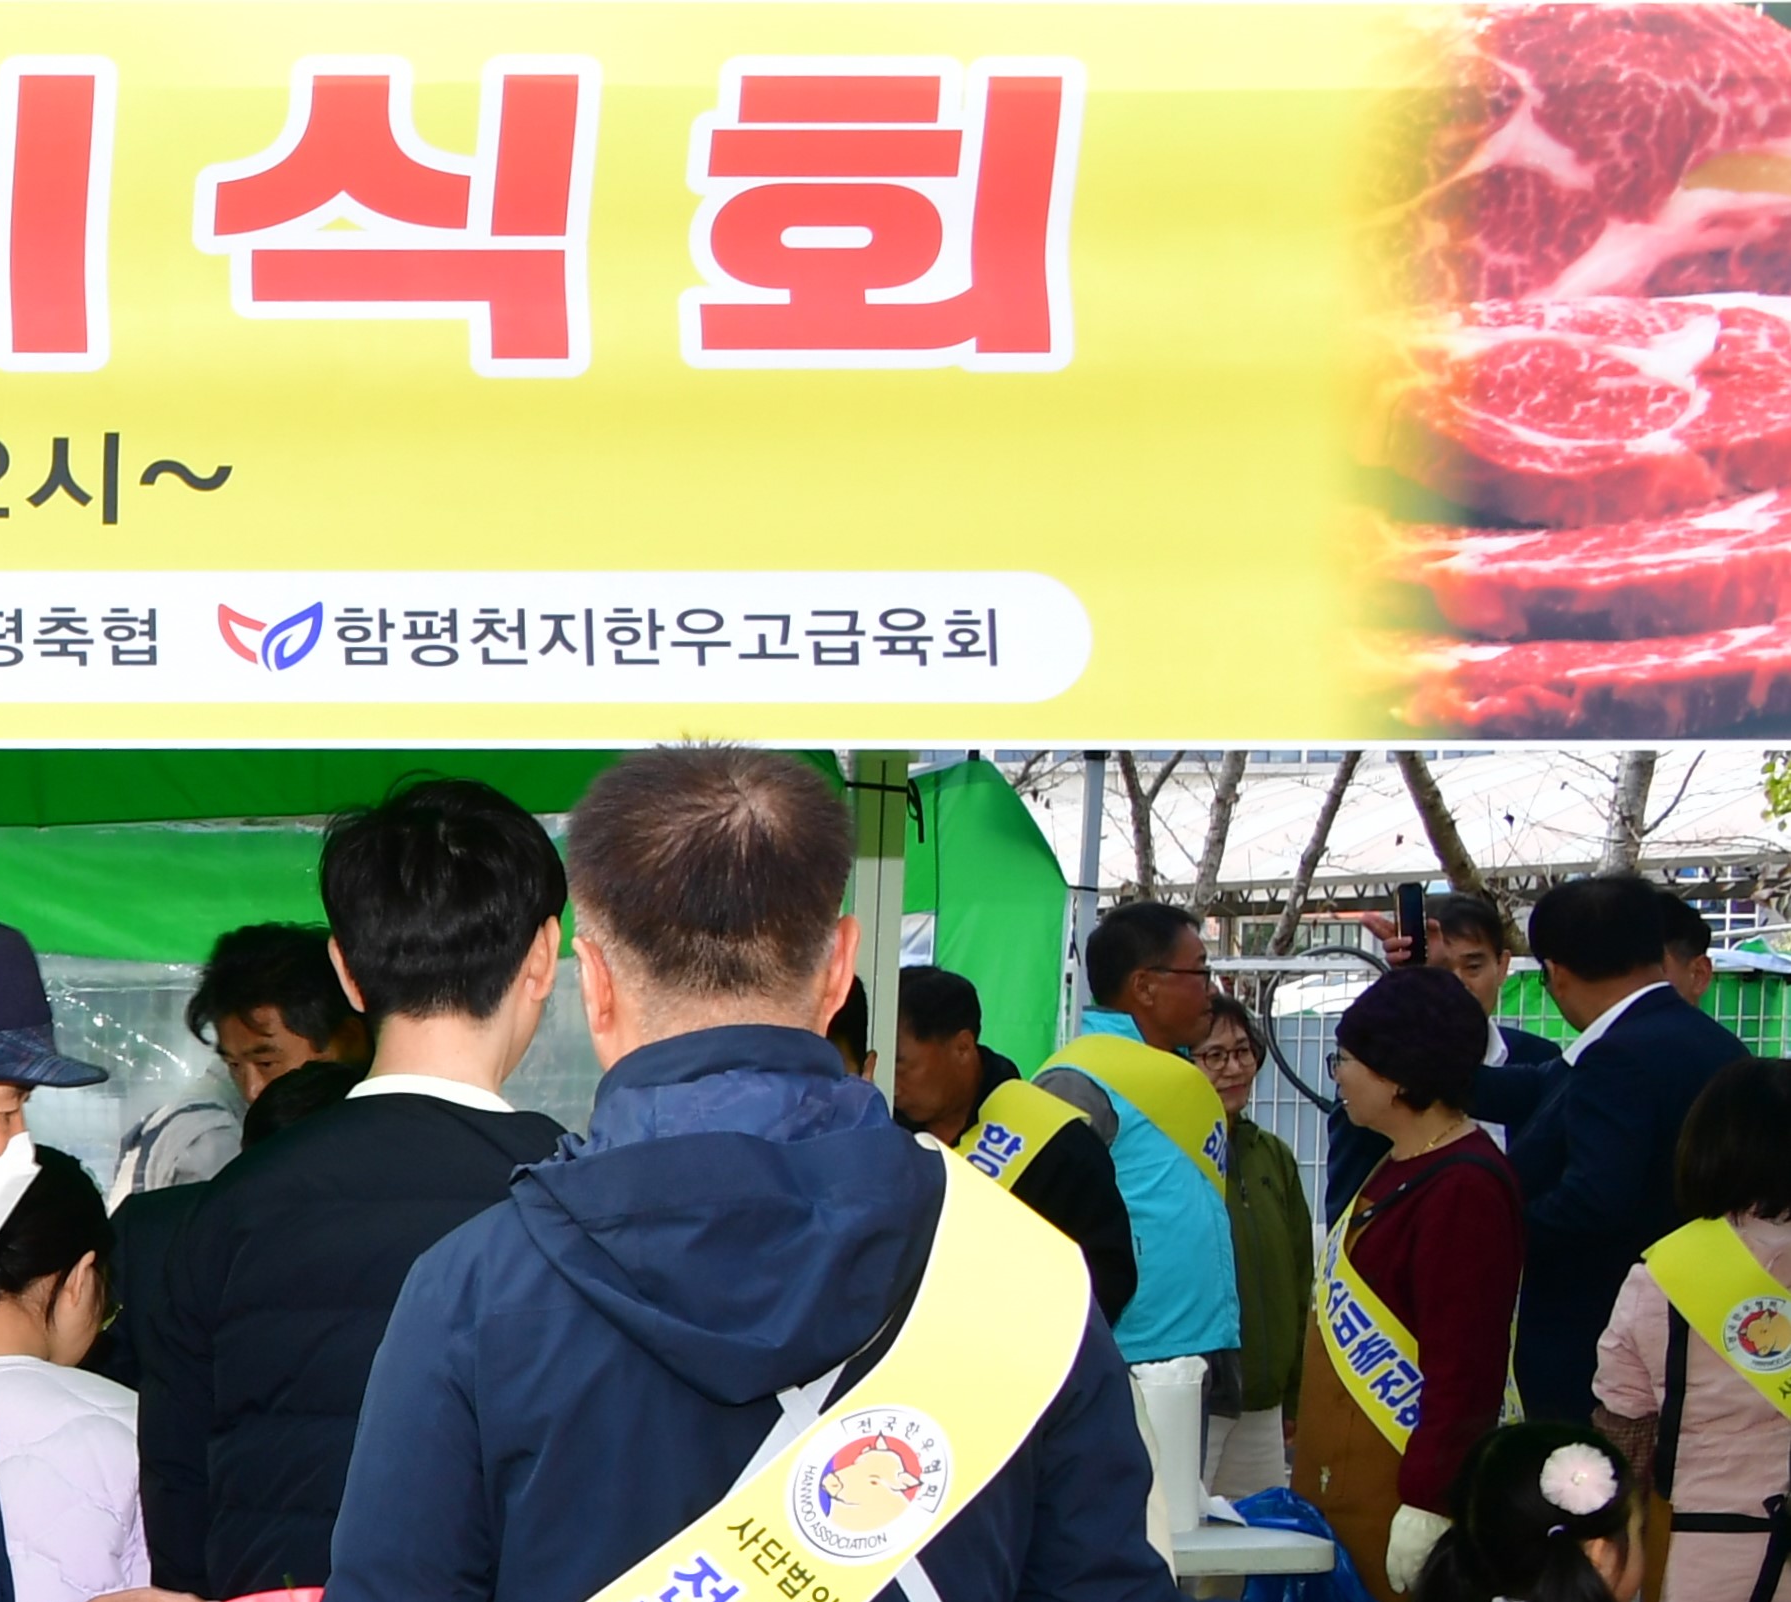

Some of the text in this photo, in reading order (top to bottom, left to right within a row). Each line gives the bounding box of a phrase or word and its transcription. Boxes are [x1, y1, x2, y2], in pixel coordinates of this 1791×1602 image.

[335, 603, 998, 668] 함평천지한우고급육회
[799, 1464, 888, 1550] HANWOO ASSOCIATION
